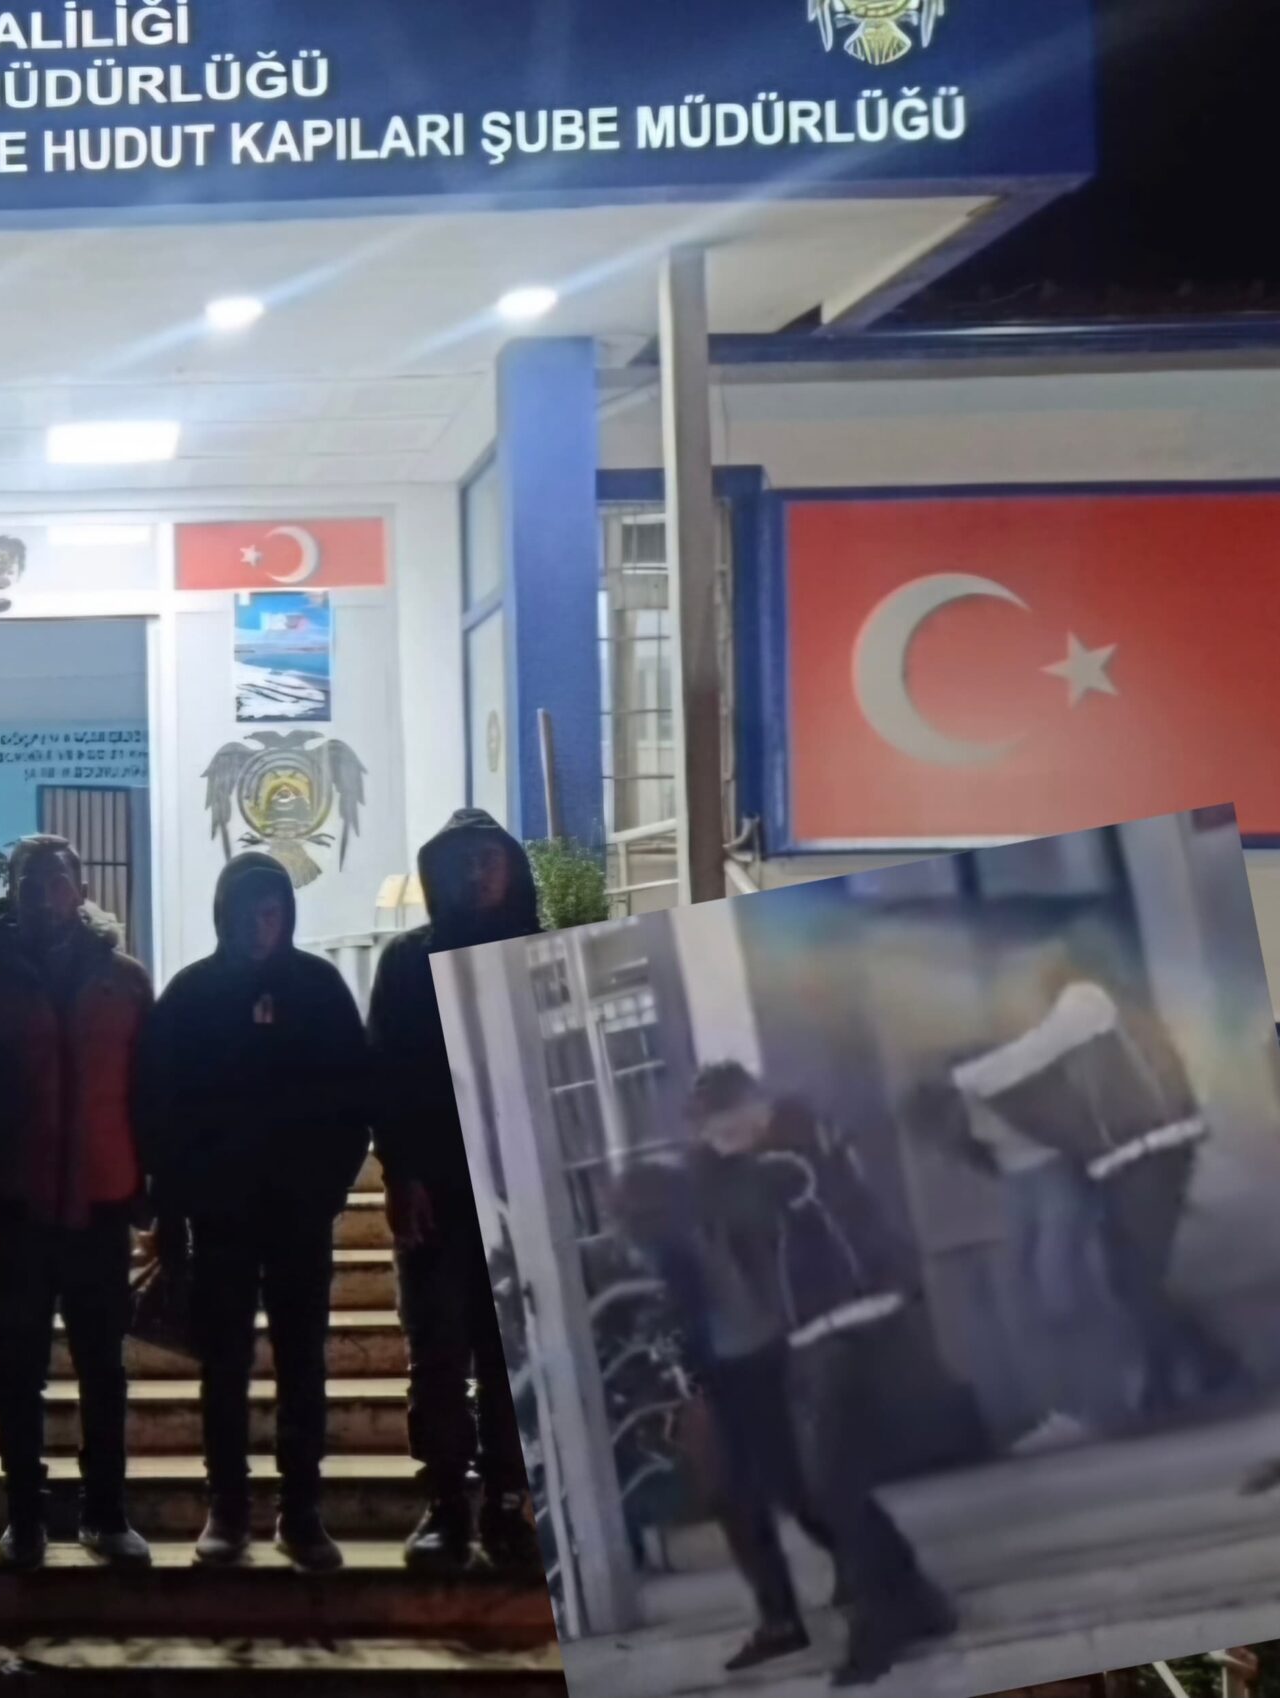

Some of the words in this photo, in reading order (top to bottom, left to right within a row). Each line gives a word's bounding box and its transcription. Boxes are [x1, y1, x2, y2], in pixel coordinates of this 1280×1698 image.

[42, 123, 217, 173] HUDUT
[230, 112, 465, 166] KAPILARI
[480, 106, 621, 166] ŞUBE
[635, 86, 967, 150] MÜDÜRLÜĞÜ
